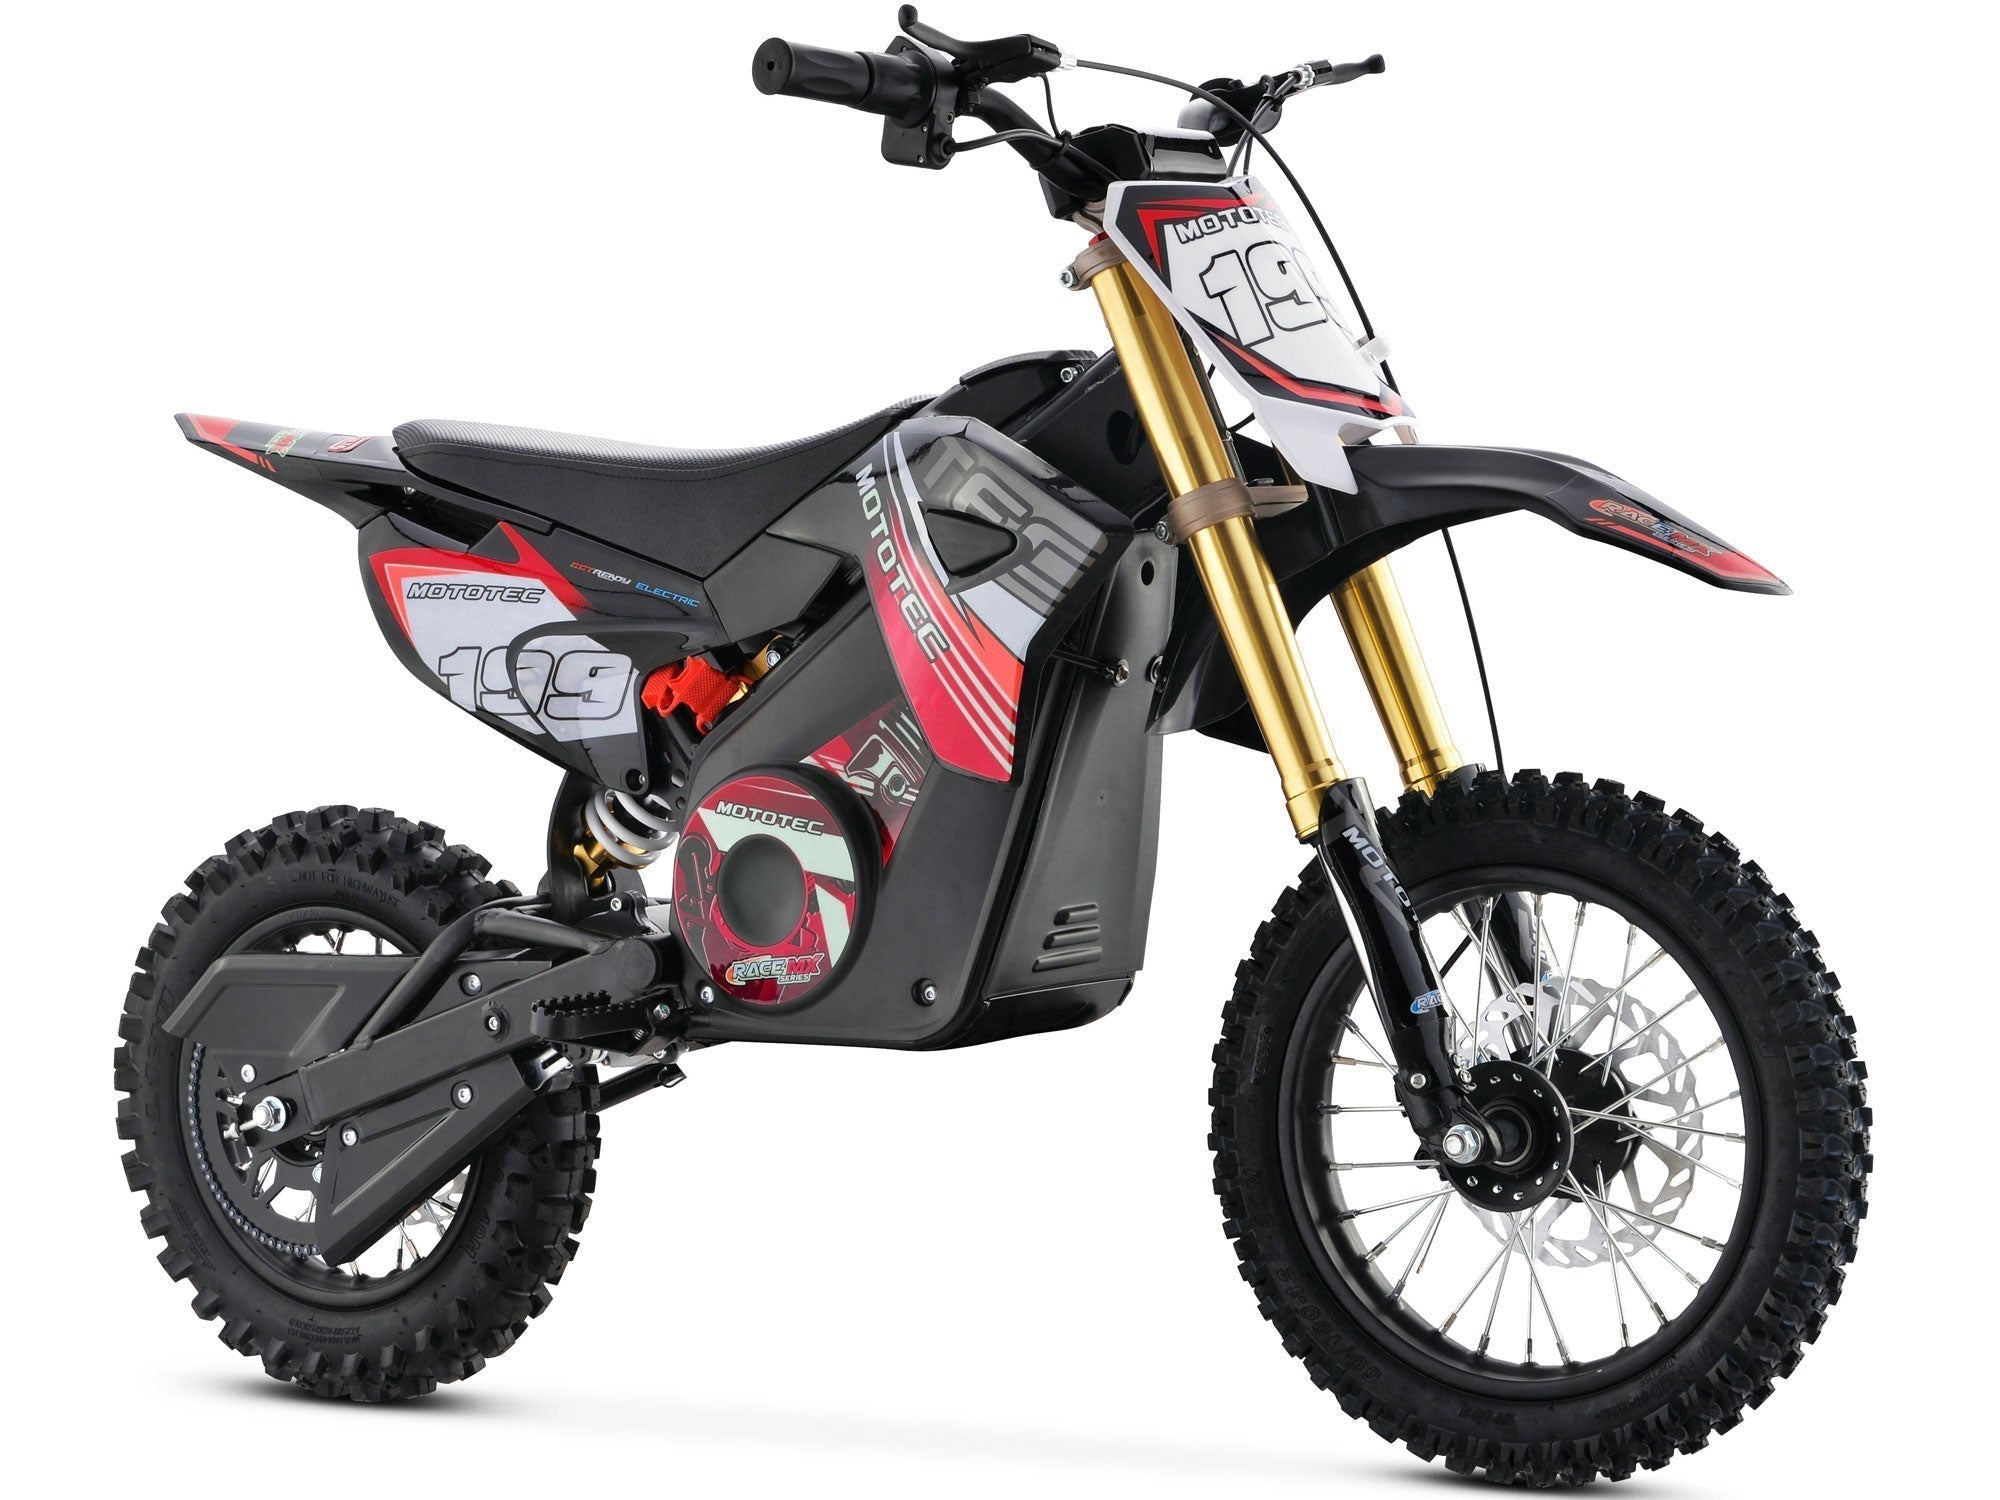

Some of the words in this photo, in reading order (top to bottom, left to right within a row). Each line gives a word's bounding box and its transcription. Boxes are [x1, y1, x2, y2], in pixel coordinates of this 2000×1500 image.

[855, 463, 951, 663] MOTOTEC
[407, 582, 545, 603] MOTOTEC
[635, 582, 700, 607] ELECTRIC
[438, 646, 632, 720] 199
[716, 800, 825, 836] MOTOTEC
[780, 973, 810, 983] SERIES
